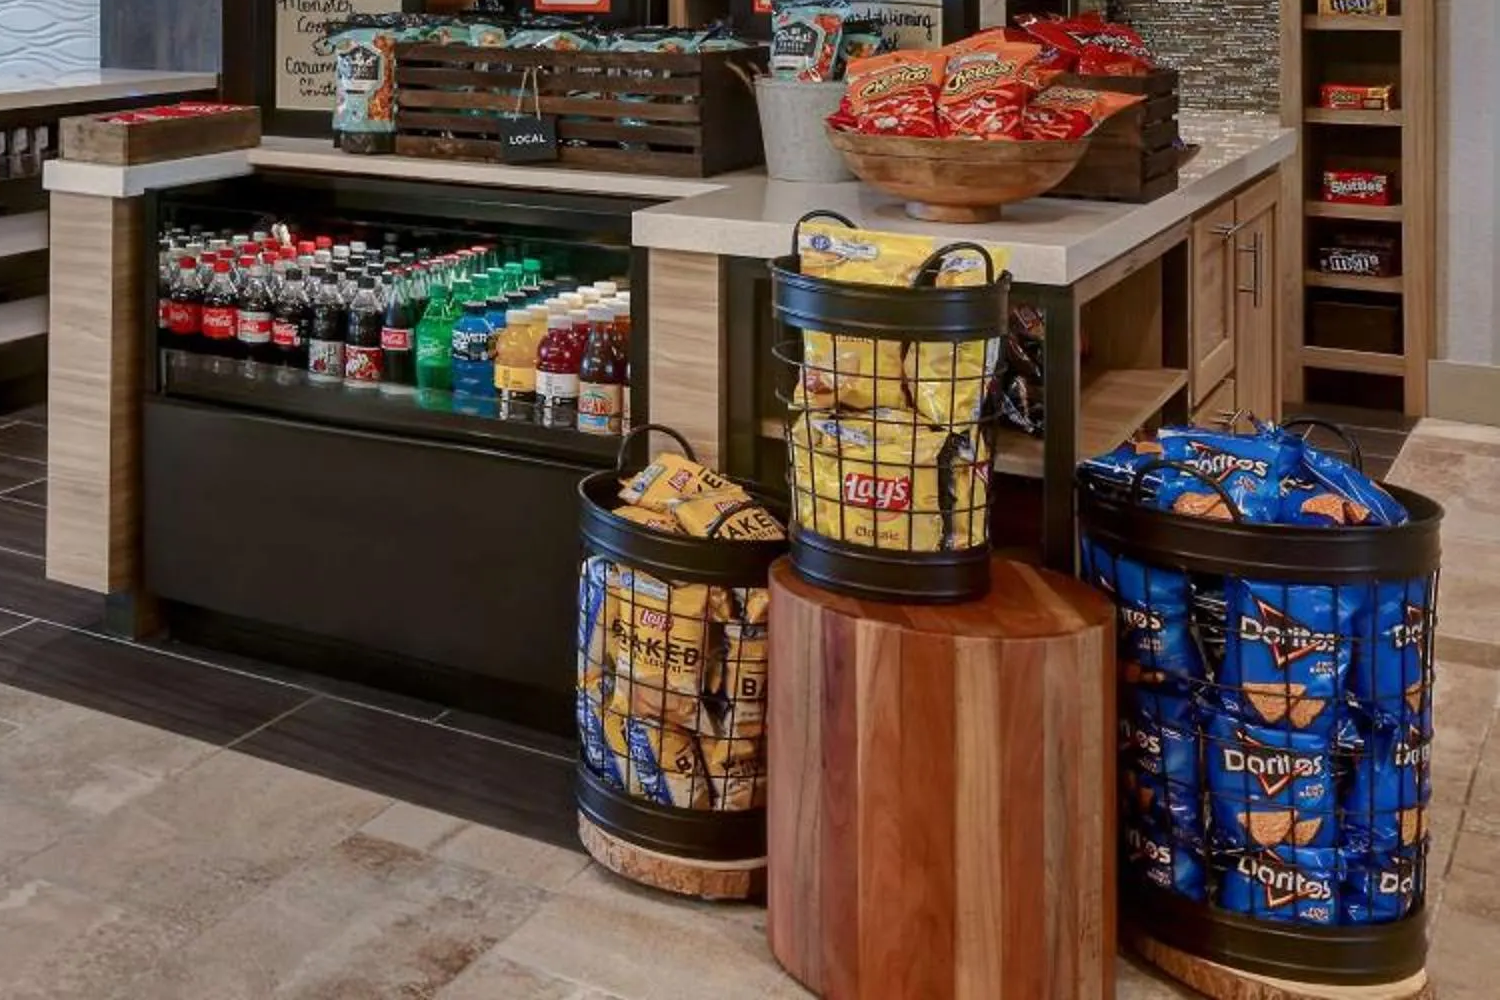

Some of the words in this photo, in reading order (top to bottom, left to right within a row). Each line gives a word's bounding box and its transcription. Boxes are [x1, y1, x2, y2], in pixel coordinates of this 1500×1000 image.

[509, 133, 548, 145] LOCAL
[1331, 178, 1384, 196] Skittles
[844, 474, 909, 508] Lay's
[855, 526, 900, 540] Clasic
[613, 618, 699, 666] BAKED
[1240, 616, 1336, 652] Doritos
[1224, 749, 1323, 777] Doritos
[1237, 856, 1332, 899] Doritos
